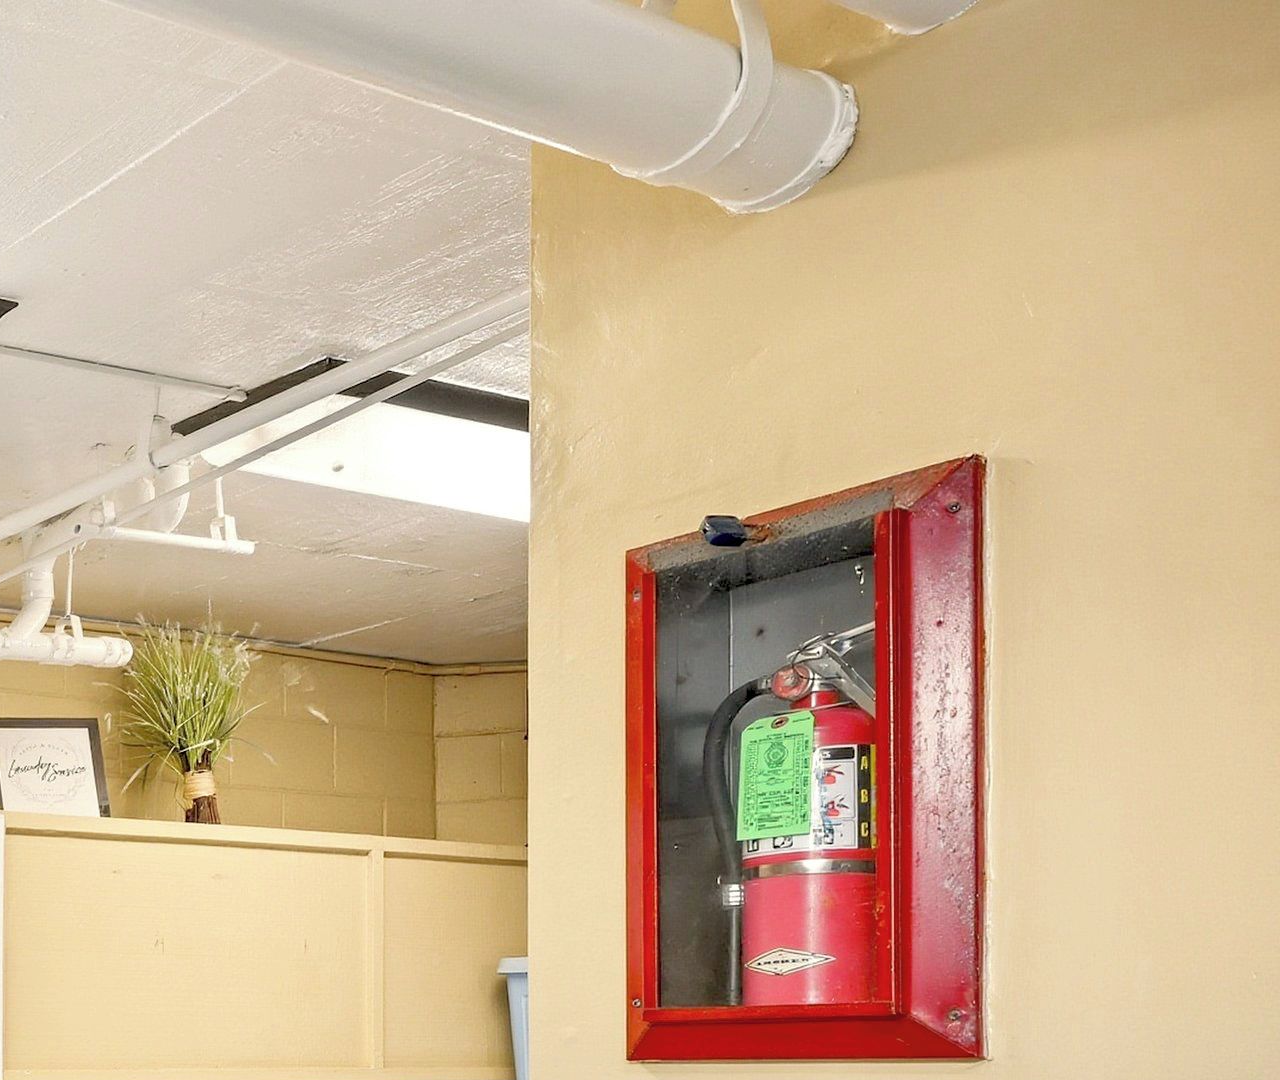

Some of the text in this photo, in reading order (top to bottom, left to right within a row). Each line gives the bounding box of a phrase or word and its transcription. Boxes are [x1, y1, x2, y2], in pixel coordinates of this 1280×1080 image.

[861, 756, 868, 770] A
[861, 789, 868, 803] B
[861, 822, 869, 837] C
